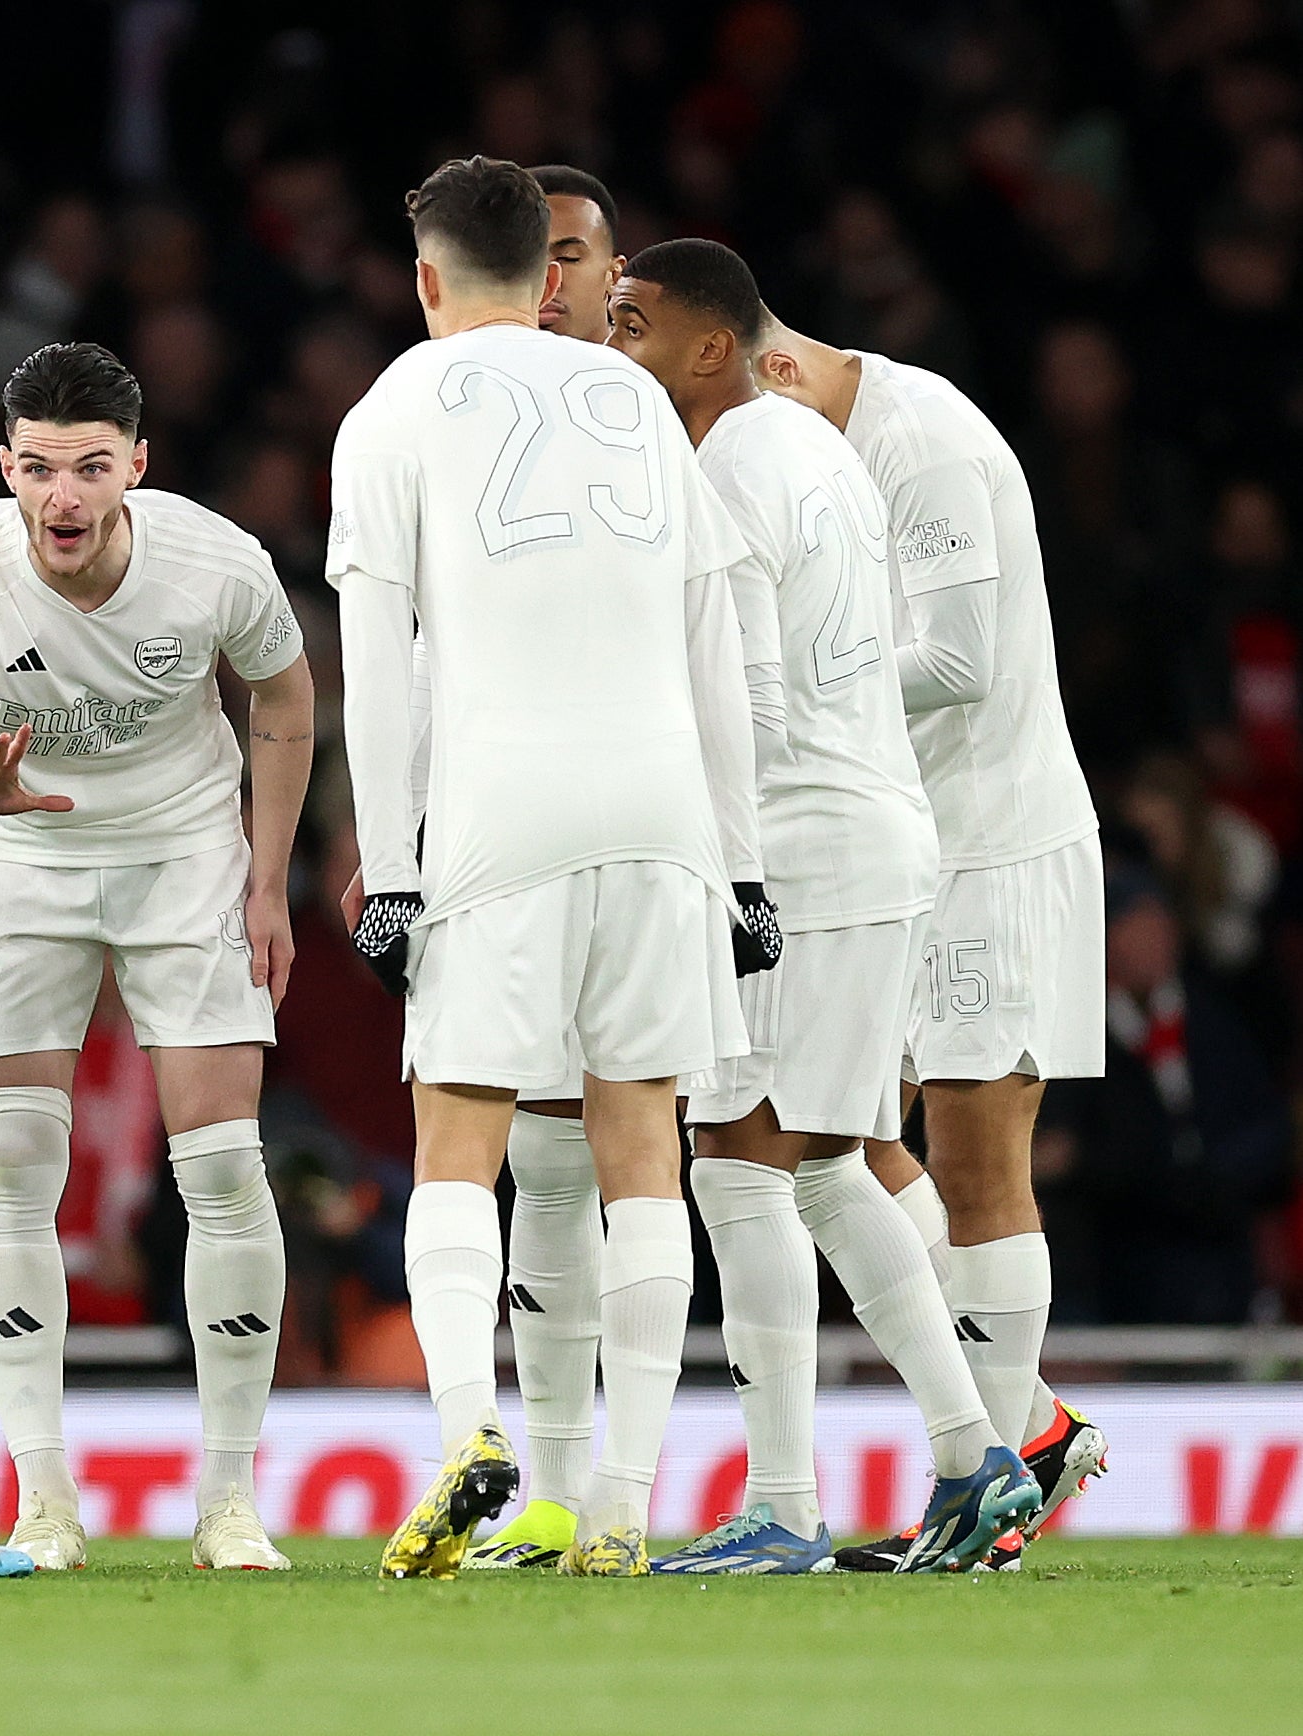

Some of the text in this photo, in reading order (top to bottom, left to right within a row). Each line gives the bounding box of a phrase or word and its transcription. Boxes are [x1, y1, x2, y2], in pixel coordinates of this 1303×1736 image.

[437, 360, 667, 557] 29
[905, 517, 950, 542] VISIT
[897, 532, 975, 563] RWANDA
[141, 643, 177, 654] Arsenal
[26, 735, 61, 757] LY
[921, 938, 990, 1020] 15
